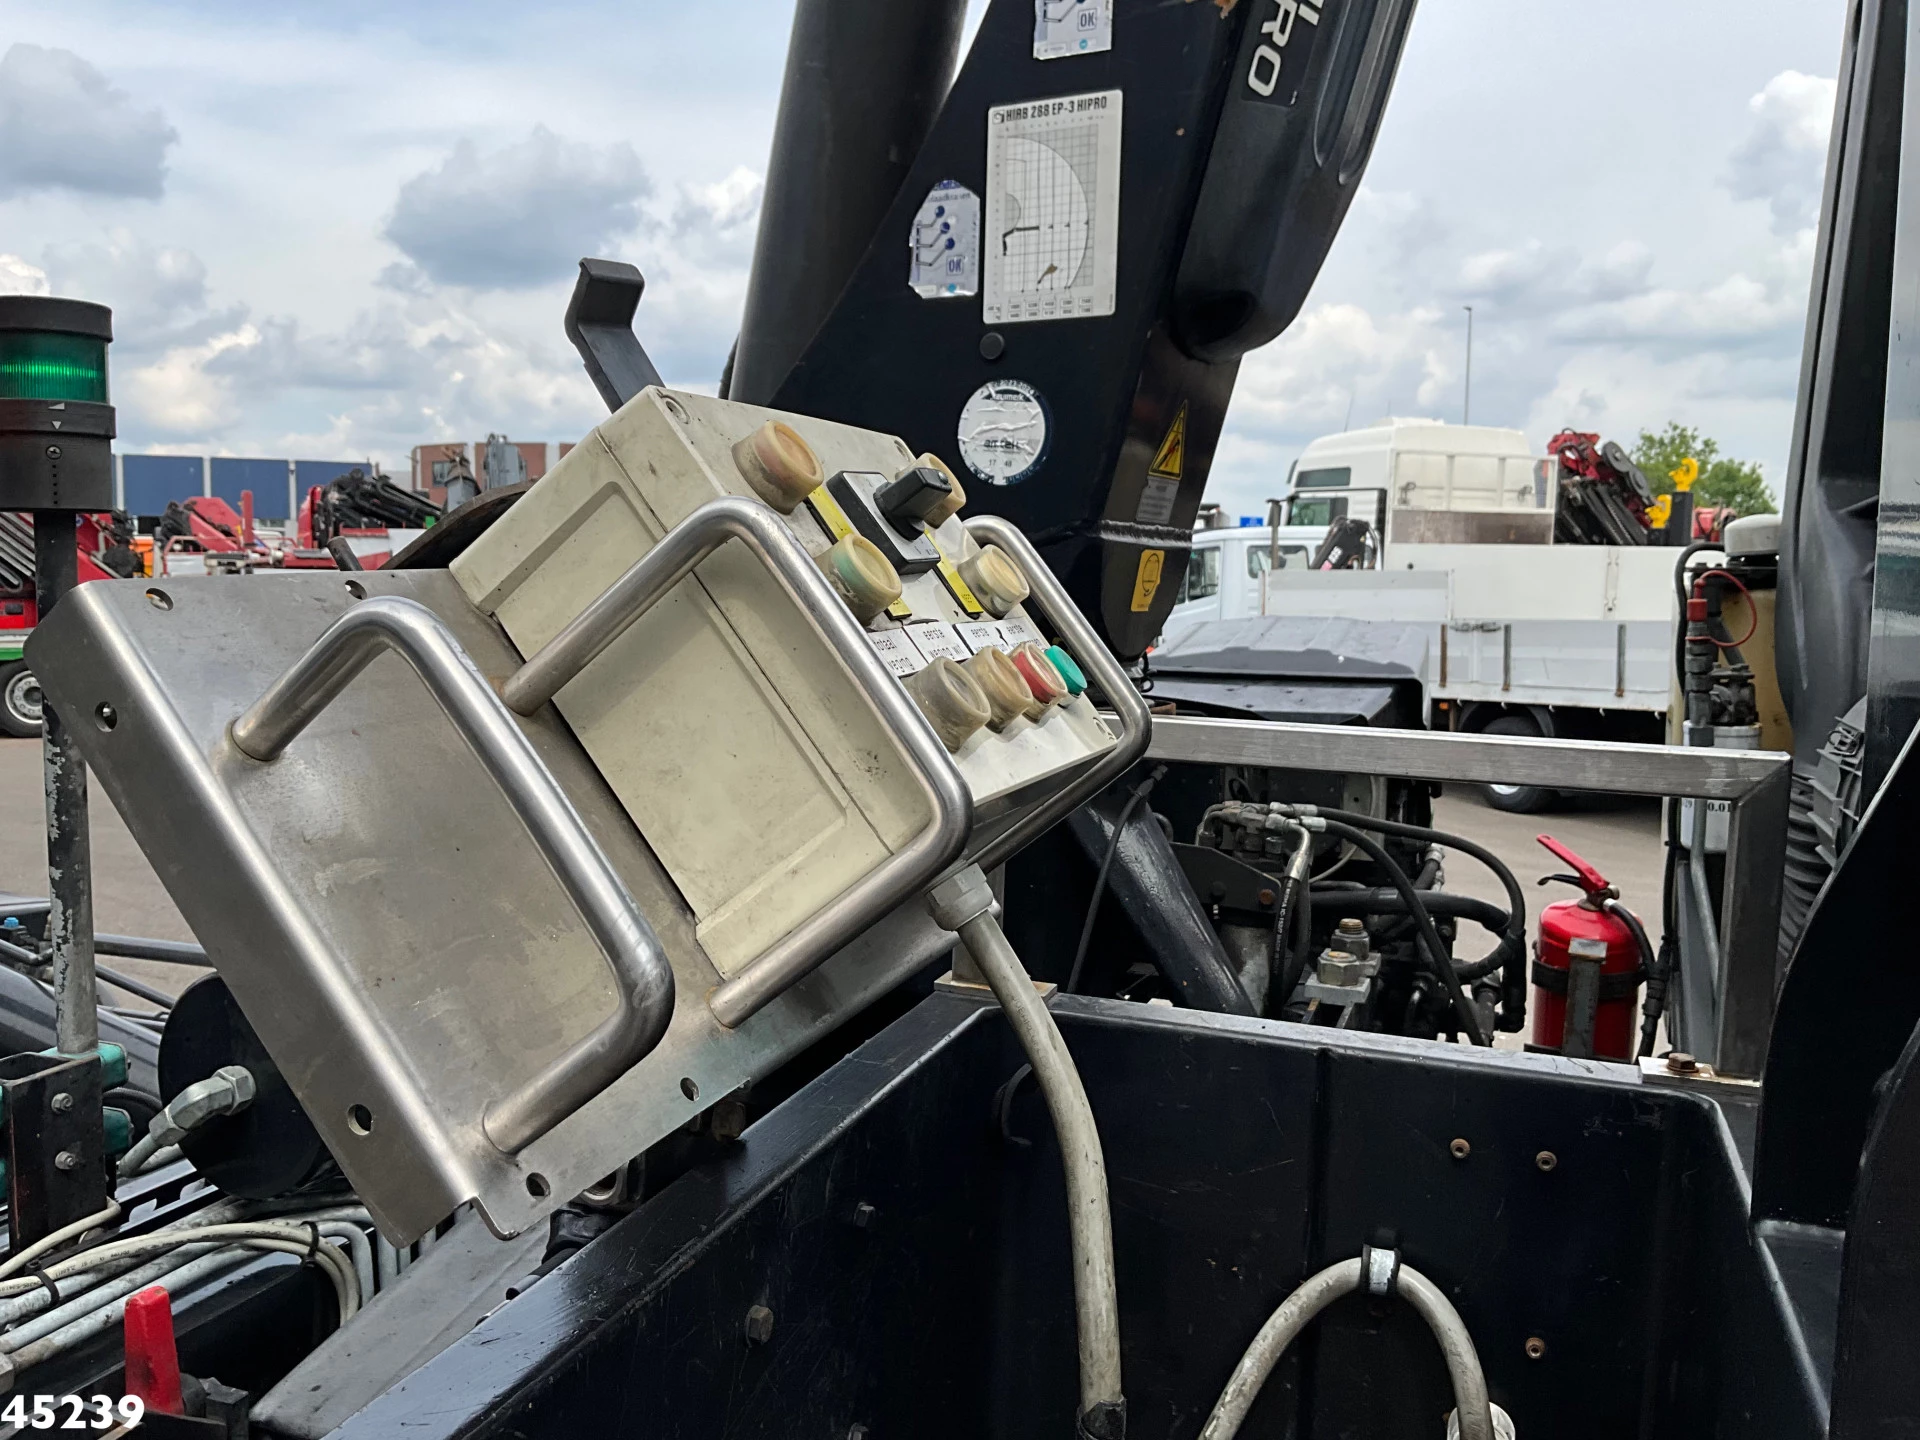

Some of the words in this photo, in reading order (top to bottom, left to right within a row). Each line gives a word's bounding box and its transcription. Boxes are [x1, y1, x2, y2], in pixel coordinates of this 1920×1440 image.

[1080, 11, 1095, 28] OK
[1248, 0, 1298, 97] RO
[1006, 107, 1029, 121] HIAB
[1052, 101, 1075, 116] EP-3
[1077, 96, 1108, 112] HIPRO
[948, 258, 962, 273] OK
[922, 627, 945, 641] eerste
[873, 635, 898, 651] totaal
